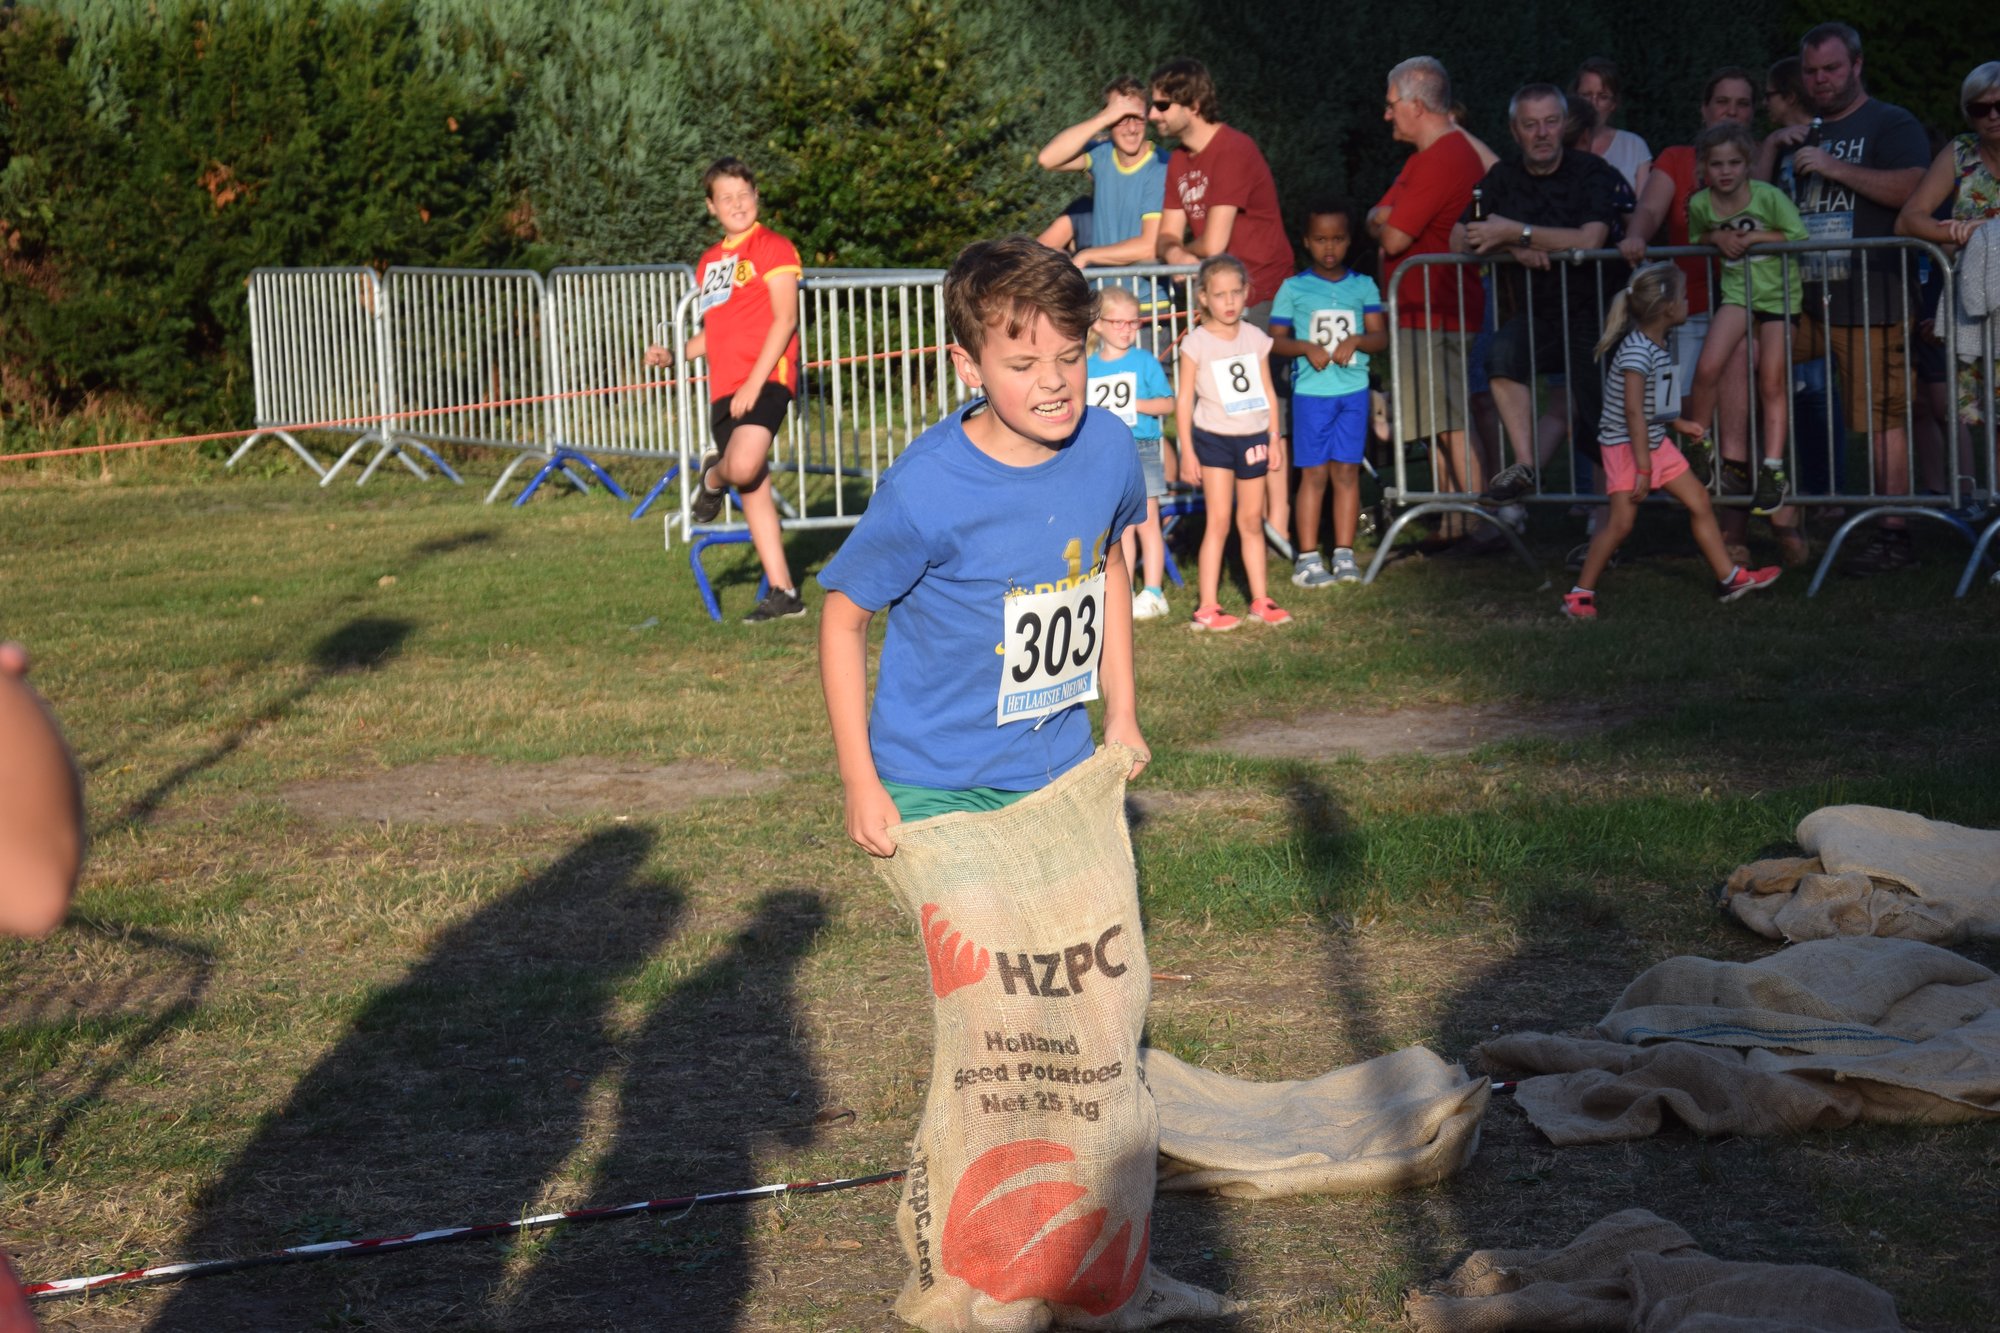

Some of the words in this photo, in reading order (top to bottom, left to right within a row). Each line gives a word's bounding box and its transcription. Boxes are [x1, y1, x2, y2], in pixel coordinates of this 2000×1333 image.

[705, 263, 734, 294] 252
[736, 265, 747, 282] 8
[1316, 315, 1350, 346] 53
[1229, 361, 1250, 393] 8
[1095, 381, 1131, 410] 29
[1012, 595, 1096, 683] 303
[1007, 694, 1027, 713] HET
[1026, 687, 1061, 710] LAATSTE
[1061, 679, 1089, 701] NIEUWS
[996, 924, 1127, 998] HZPC
[984, 1031, 1080, 1055] Holland
[1019, 1062, 1123, 1084] Potatoes
[980, 1094, 1029, 1114] Net
[1034, 1091, 1065, 1112] 25
[1072, 1094, 1100, 1122] kg
